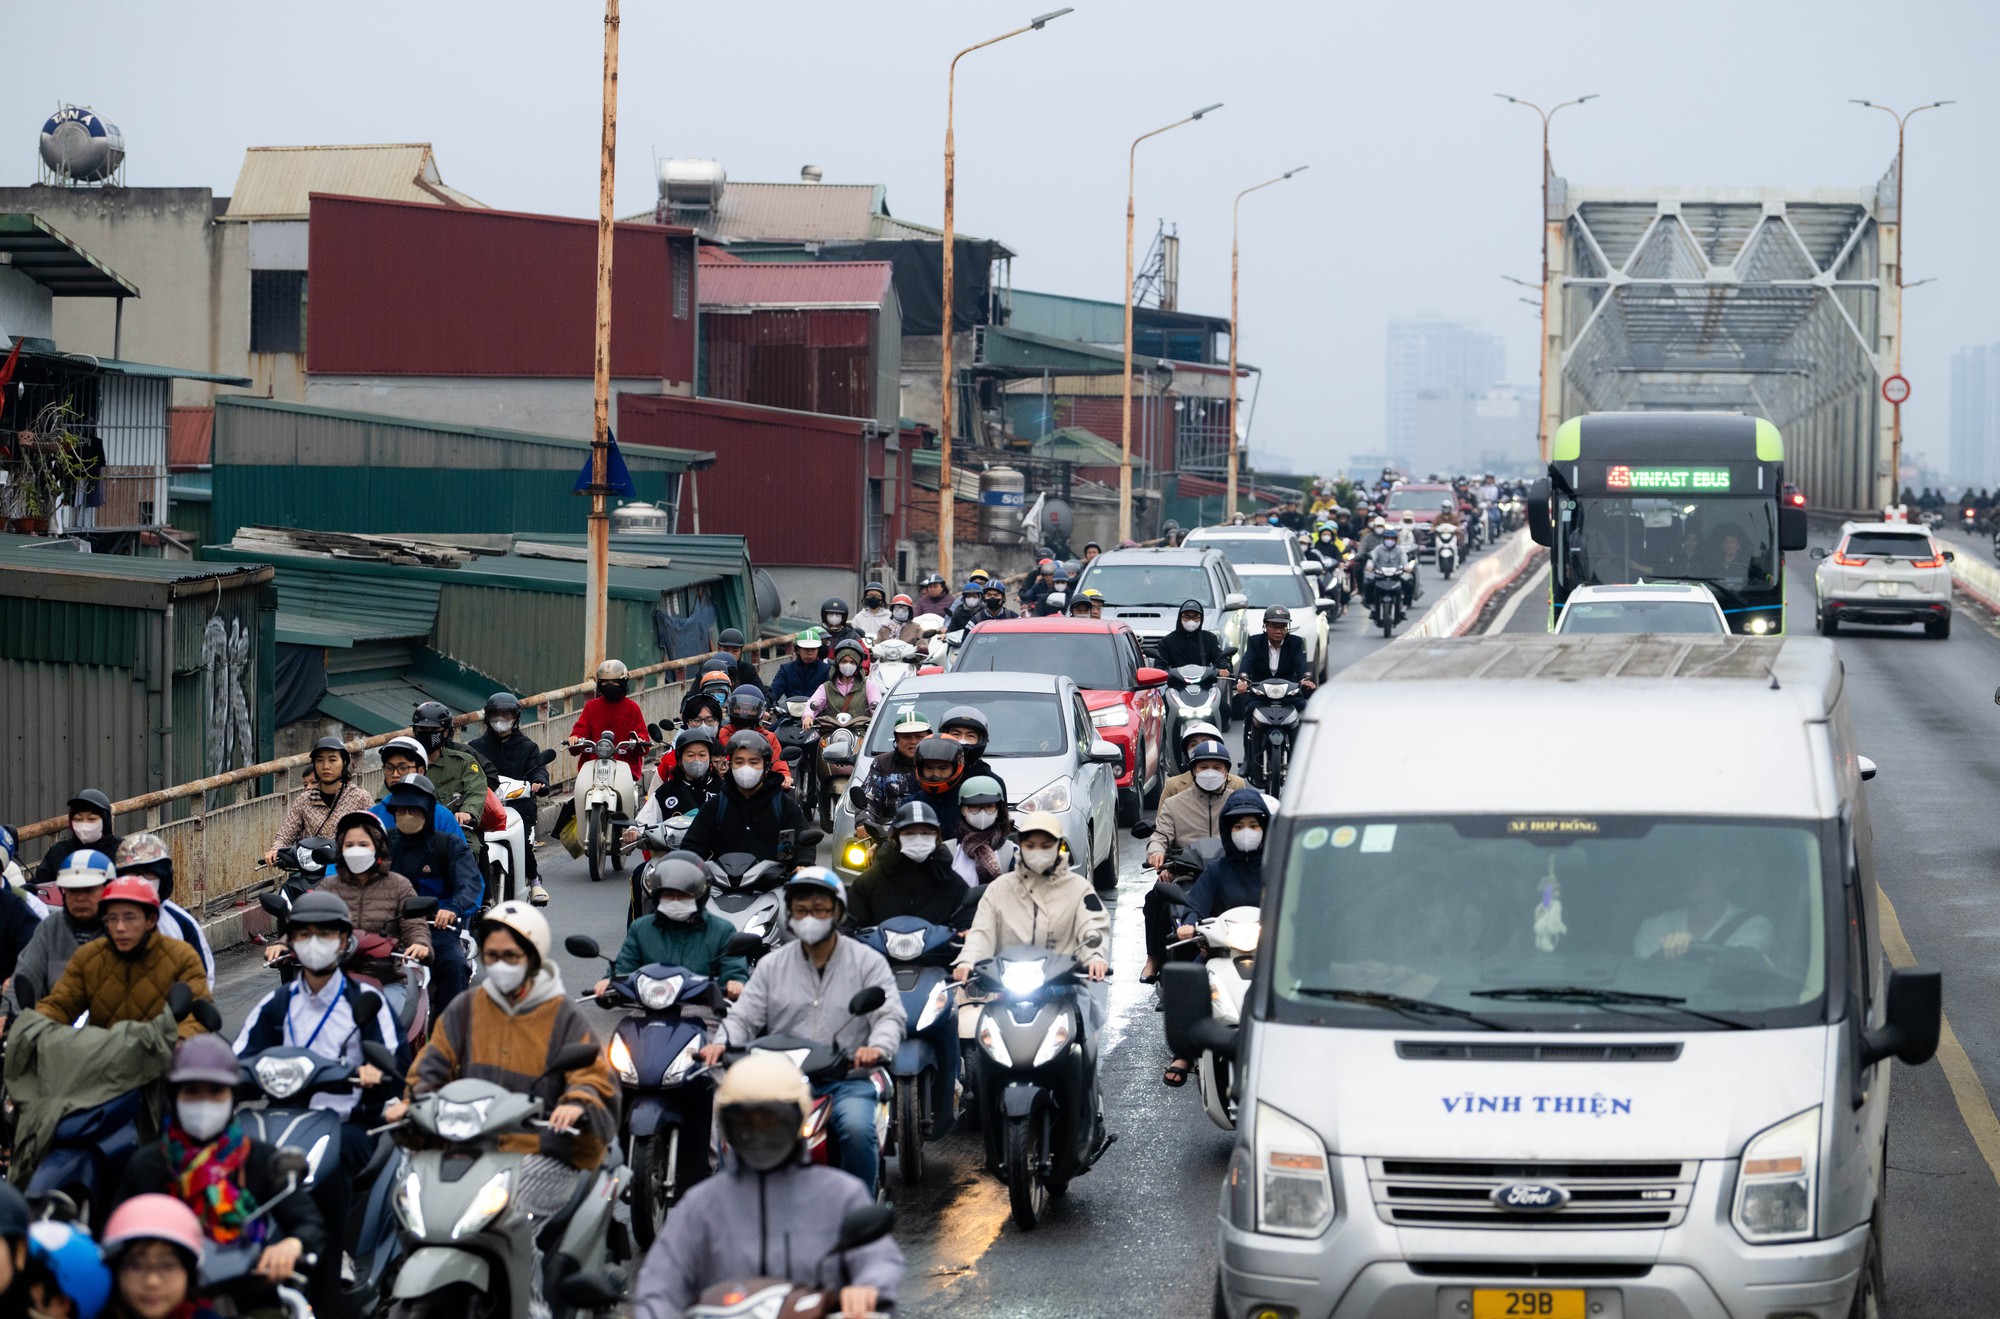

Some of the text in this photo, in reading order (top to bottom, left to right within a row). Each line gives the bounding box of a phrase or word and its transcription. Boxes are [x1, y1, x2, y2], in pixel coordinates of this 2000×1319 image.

[1629, 471, 1689, 488] VINFAST
[1692, 471, 1730, 488] EBUS
[1441, 1091, 1632, 1118] VĨNH THIỆN
[1507, 1184, 1552, 1205] Ford
[1505, 1291, 1554, 1316] 29B
